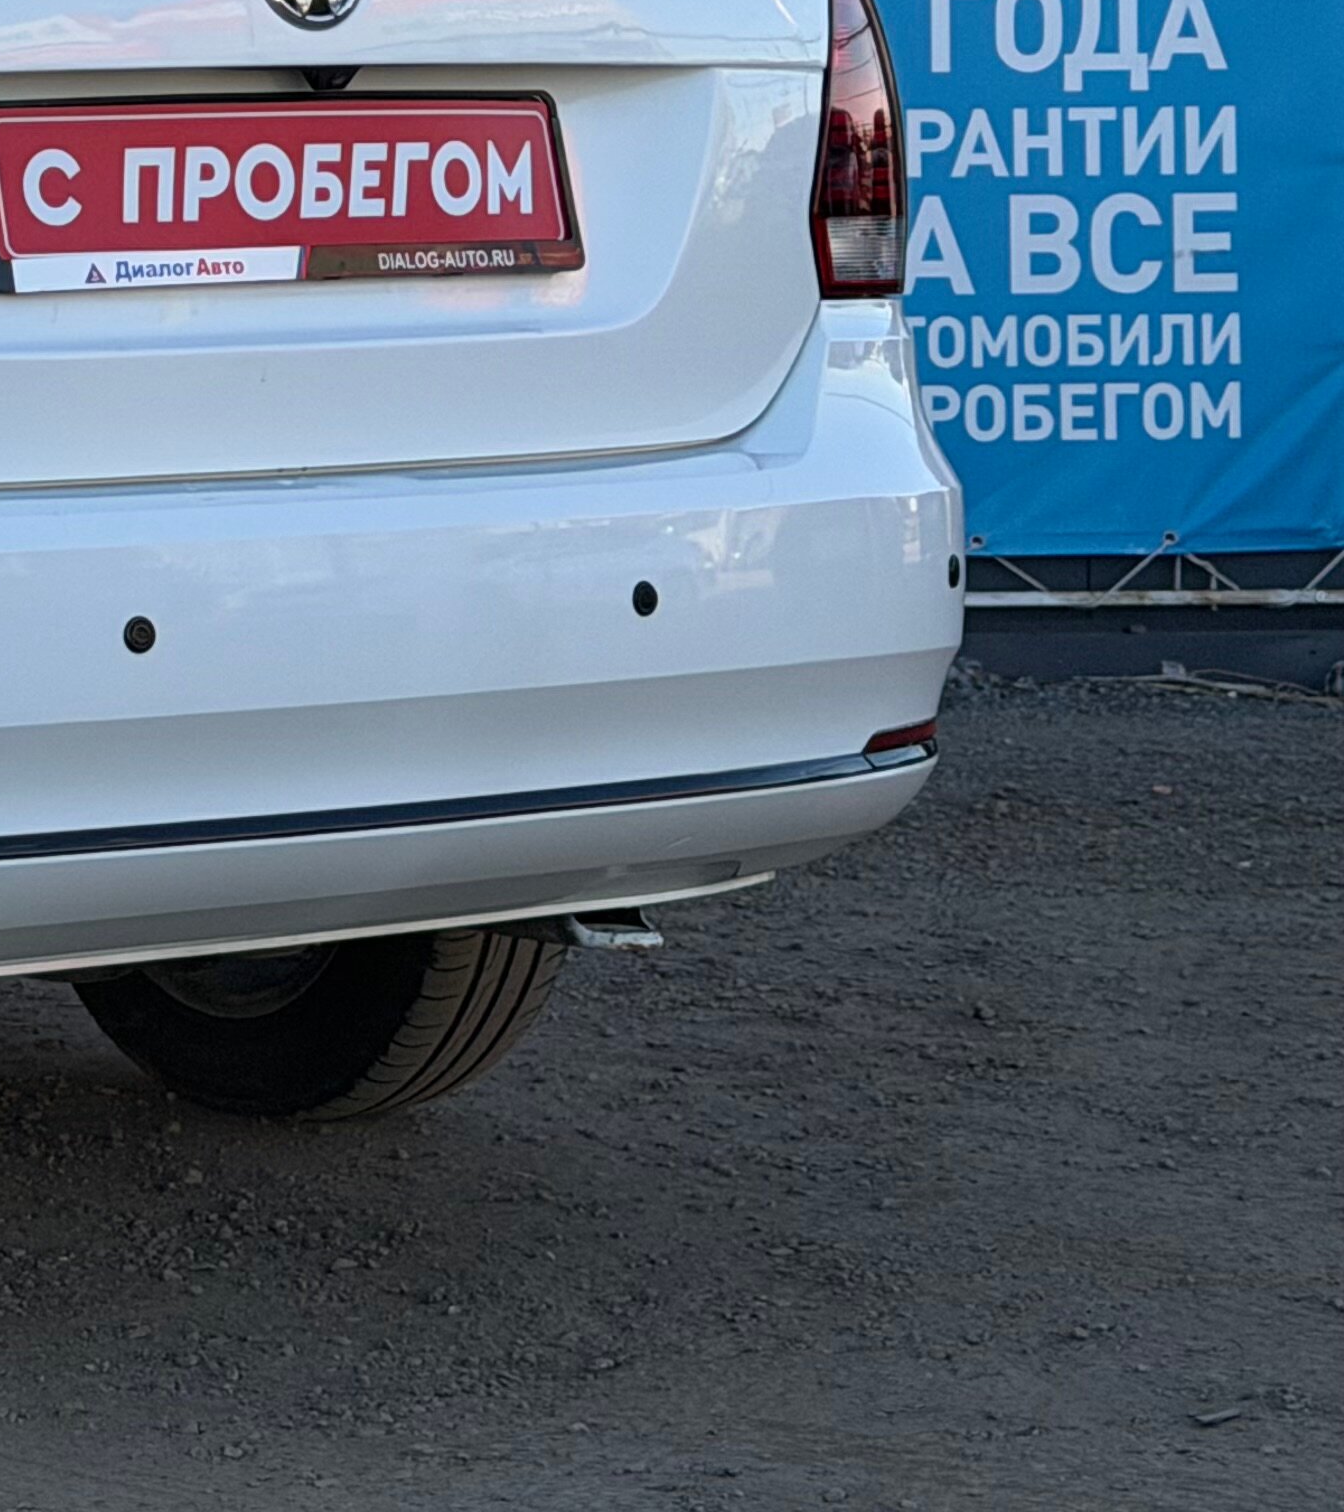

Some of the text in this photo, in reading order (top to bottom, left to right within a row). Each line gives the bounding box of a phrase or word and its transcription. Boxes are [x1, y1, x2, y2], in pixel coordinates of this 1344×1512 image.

[22, 139, 534, 227] С ПРОБЕГОМ
[377, 248, 515, 271] DIALOG-AUTO.RU
[1009, 192, 1239, 295] ВСЕ
